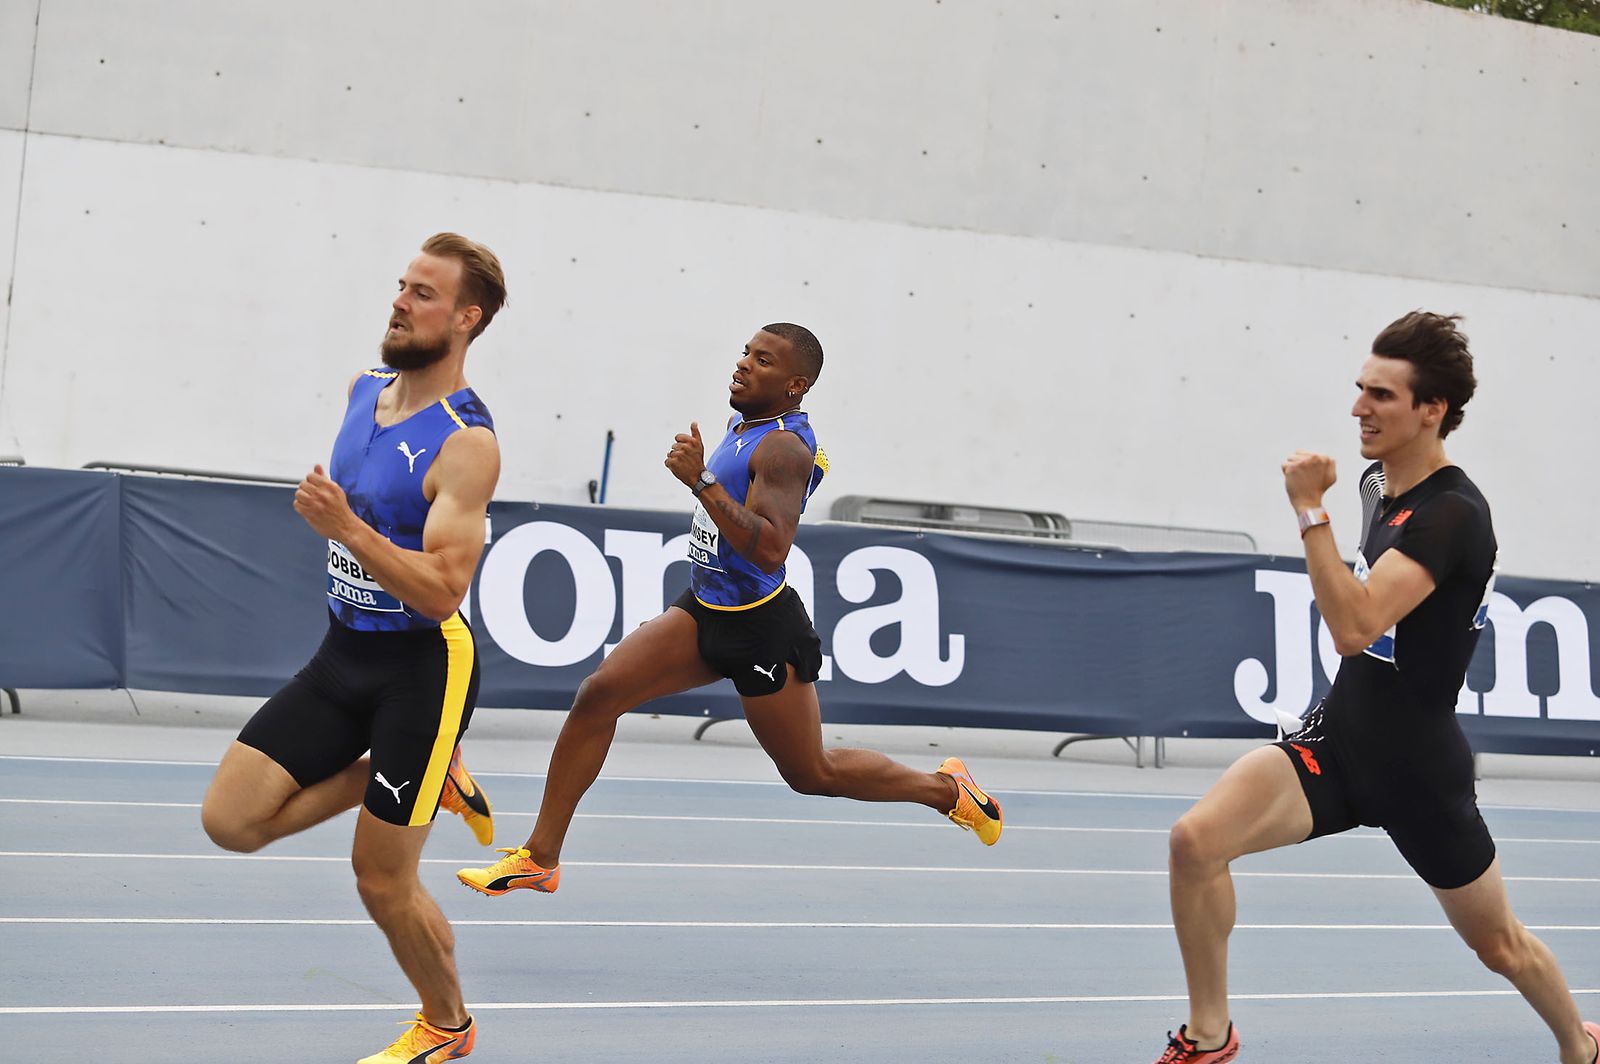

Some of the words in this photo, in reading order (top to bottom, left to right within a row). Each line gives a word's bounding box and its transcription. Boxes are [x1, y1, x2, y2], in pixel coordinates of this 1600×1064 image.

[328, 548, 376, 582] OBB
[331, 578, 377, 605] Joma
[458, 518, 965, 687] oa
[1233, 569, 1600, 725] Jm
